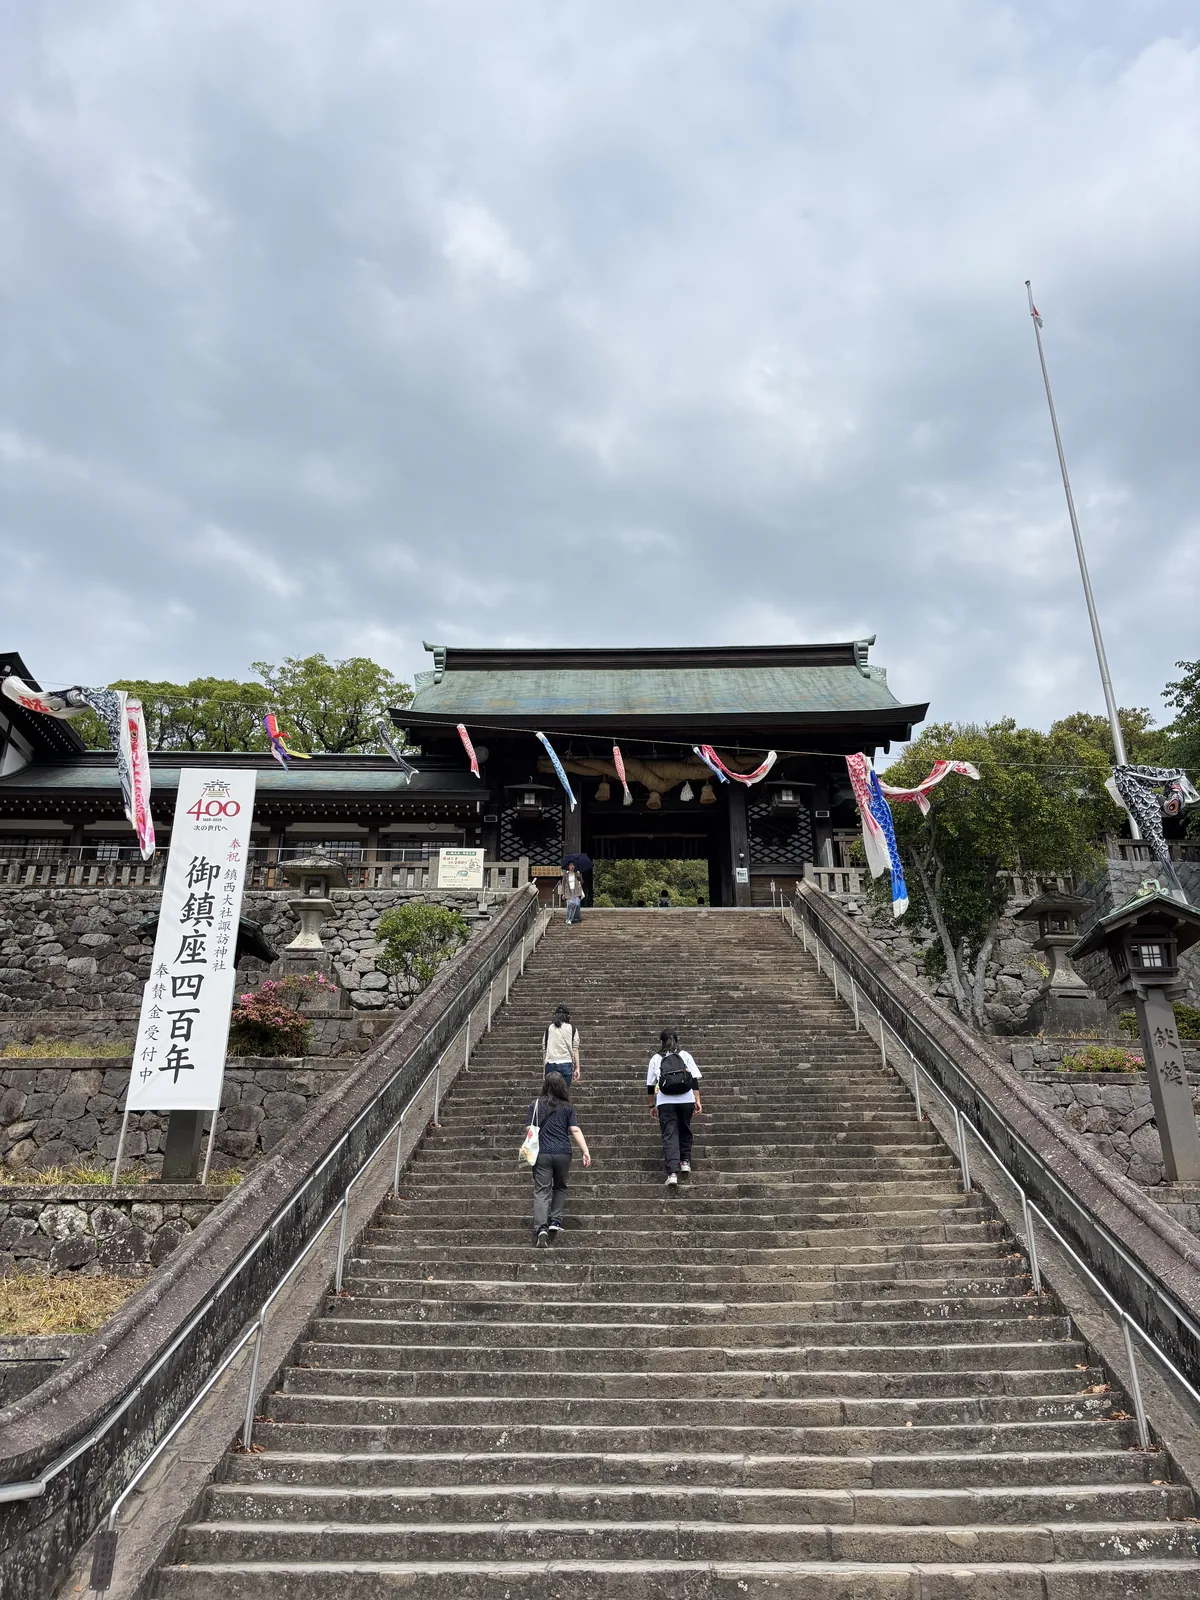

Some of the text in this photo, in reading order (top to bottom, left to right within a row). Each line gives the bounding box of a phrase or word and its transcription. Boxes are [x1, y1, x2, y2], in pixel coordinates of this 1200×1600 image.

[186, 799, 241, 821] 400
[139, 962, 169, 1084] 奉賛金受付中
[158, 855, 222, 1085] 御鎮座四百年
